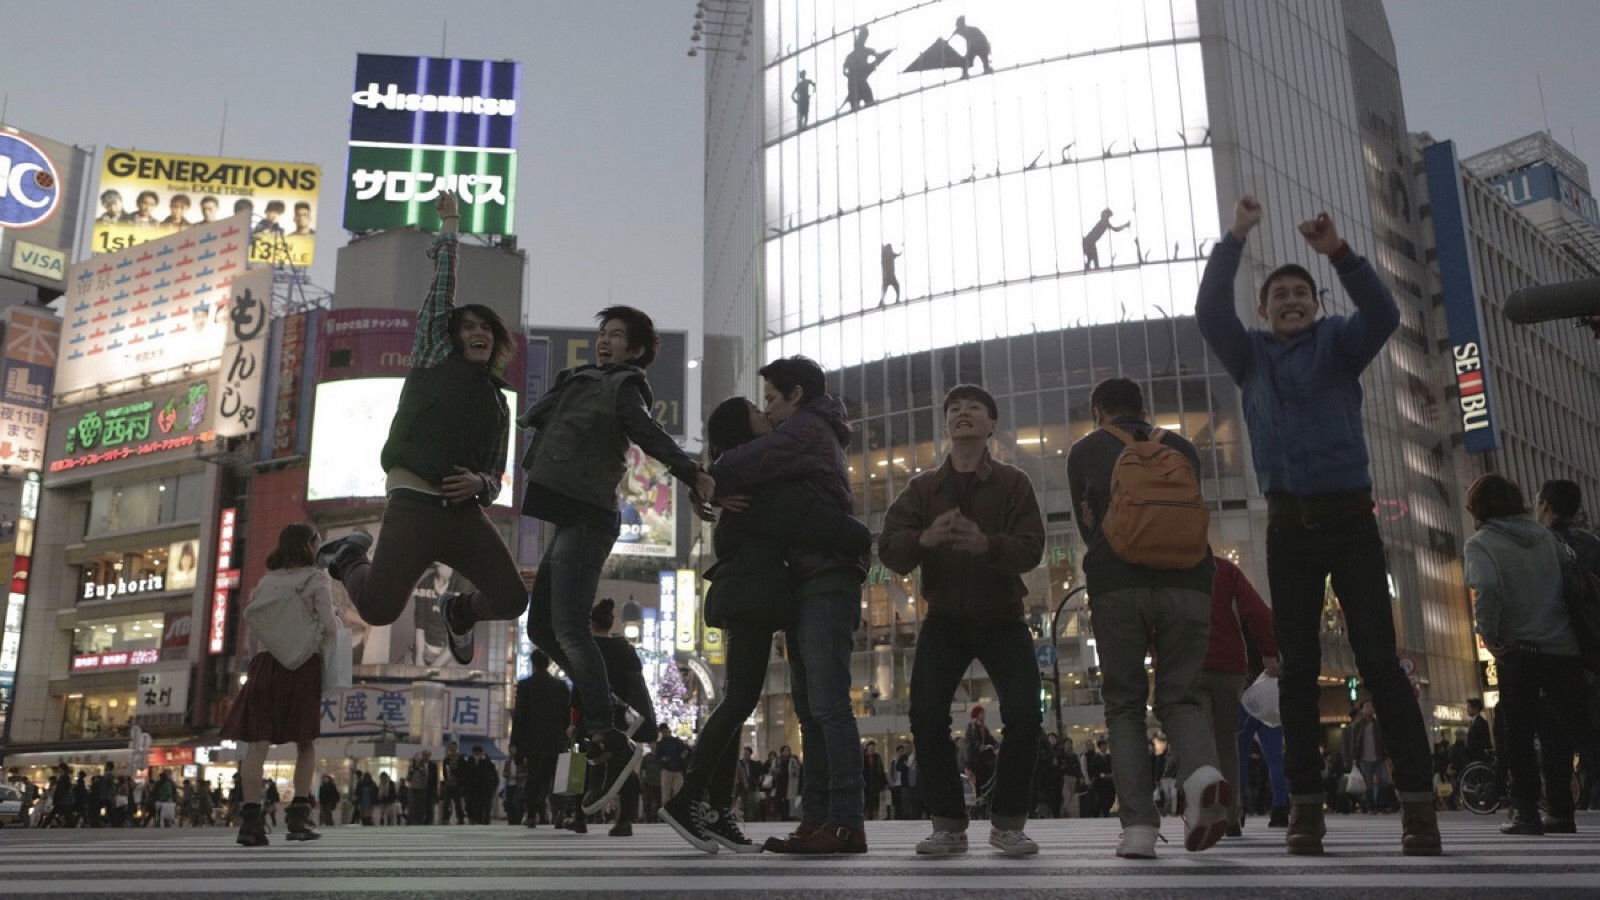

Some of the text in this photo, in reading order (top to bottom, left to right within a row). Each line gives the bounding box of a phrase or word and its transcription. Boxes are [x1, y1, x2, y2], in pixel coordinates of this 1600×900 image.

[352, 83, 516, 116] Hisamitsu
[107, 152, 316, 191] GENERATIONS
[352, 169, 505, 205] サロンパス
[20, 251, 62, 273] VISA
[6, 316, 60, 364] 本
[220, 288, 266, 429] もんじゃ
[1453, 341, 1490, 433] SEIBU
[8, 424, 35, 440] まで
[103, 412, 152, 446] 西村
[84, 575, 164, 600] Euphoria
